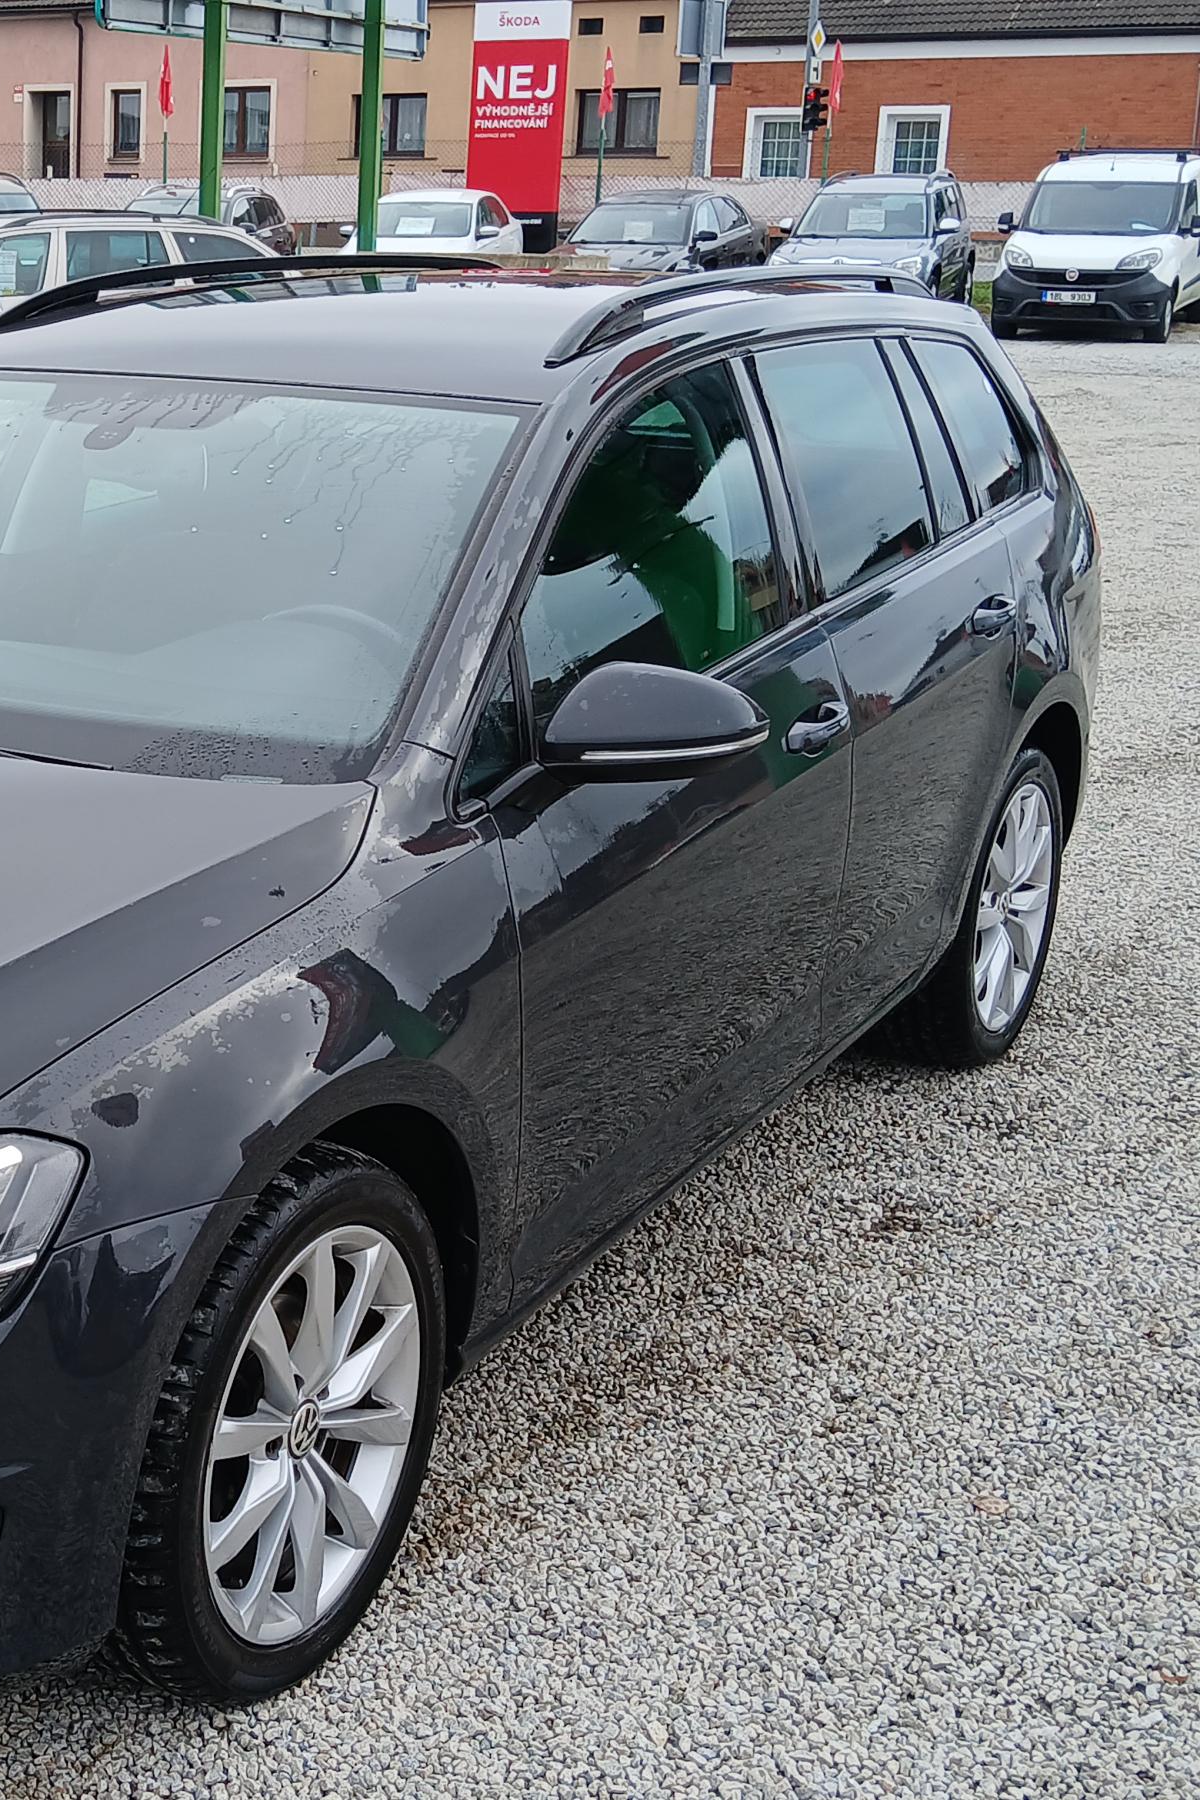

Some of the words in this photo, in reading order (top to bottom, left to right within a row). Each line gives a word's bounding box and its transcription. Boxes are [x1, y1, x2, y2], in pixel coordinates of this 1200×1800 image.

[499, 15, 541, 27] ŠKODA
[476, 64, 557, 100] NEJ
[476, 103, 554, 116] VÝHODNĚJŠÍ
[474, 117, 548, 129] FINANCOVÁNÍ
